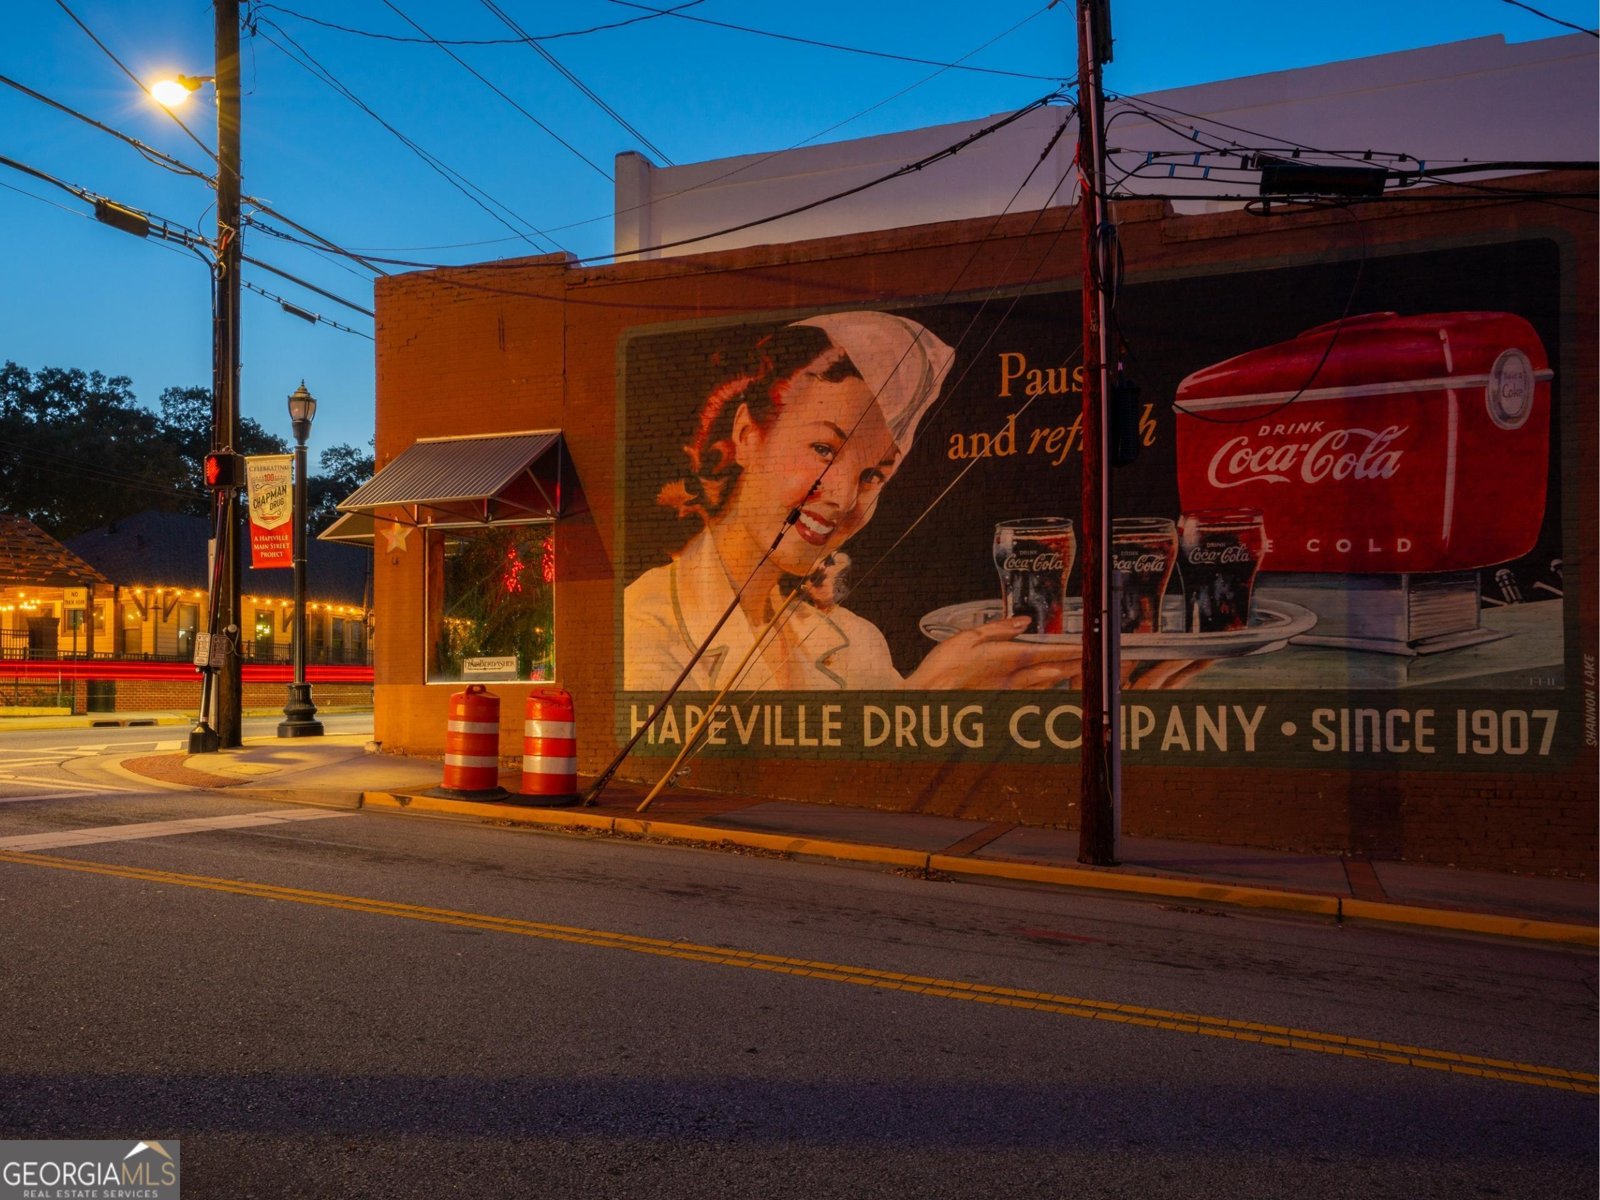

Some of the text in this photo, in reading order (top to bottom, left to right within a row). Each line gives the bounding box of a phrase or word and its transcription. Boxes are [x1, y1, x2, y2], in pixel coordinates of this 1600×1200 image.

[997, 352, 1084, 398] Paus
[1502, 383, 1523, 399] Coke
[947, 403, 1158, 467] and refh
[1258, 420, 1326, 437] DRINK
[1207, 425, 1410, 488] Coca-Cola
[249, 465, 290, 473] CELEBRATING
[264, 473, 274, 482] 100
[253, 485, 287, 509] CHAPMAN
[269, 497, 285, 511] DRUG
[1188, 544, 1250, 565] Coca-Cola
[1306, 538, 1412, 553] COLD
[1003, 553, 1065, 572] Coca-Cola
[1112, 553, 1165, 573] oca-Cola
[1583, 653, 1598, 748] SHANNON LAKE
[629, 704, 1559, 756] HAPEVILLE DRUG COPANY SINCE 1907
